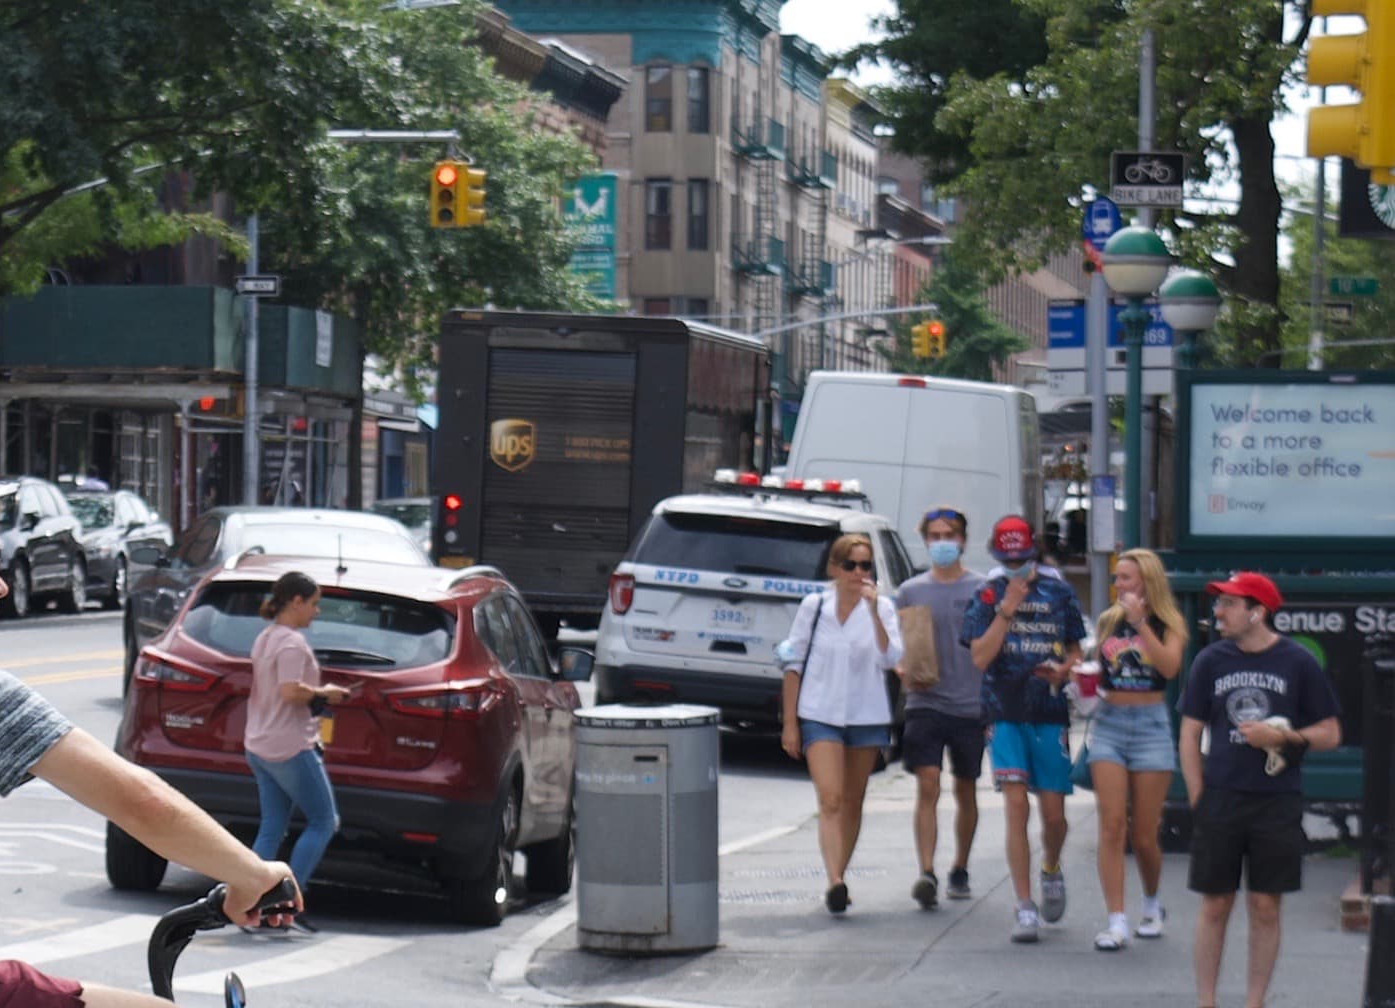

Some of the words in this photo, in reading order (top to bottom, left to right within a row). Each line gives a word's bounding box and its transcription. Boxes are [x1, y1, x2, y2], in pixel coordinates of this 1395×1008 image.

[1115, 189, 1143, 201] BIKE
[1148, 188, 1181, 201] LANE
[1211, 403, 1312, 424] Welcome
[1320, 404, 1375, 424] back
[493, 435, 532, 463] ups
[1211, 432, 1232, 449] to
[1242, 436, 1256, 449] a
[1263, 436, 1322, 449] more
[1211, 457, 1290, 477] flexible
[1297, 459, 1362, 477] office
[655, 570, 700, 584] NYPD
[763, 580, 825, 594] POLICE
[1274, 611, 1344, 632] enue
[1214, 672, 1286, 696] BROOKLYN
